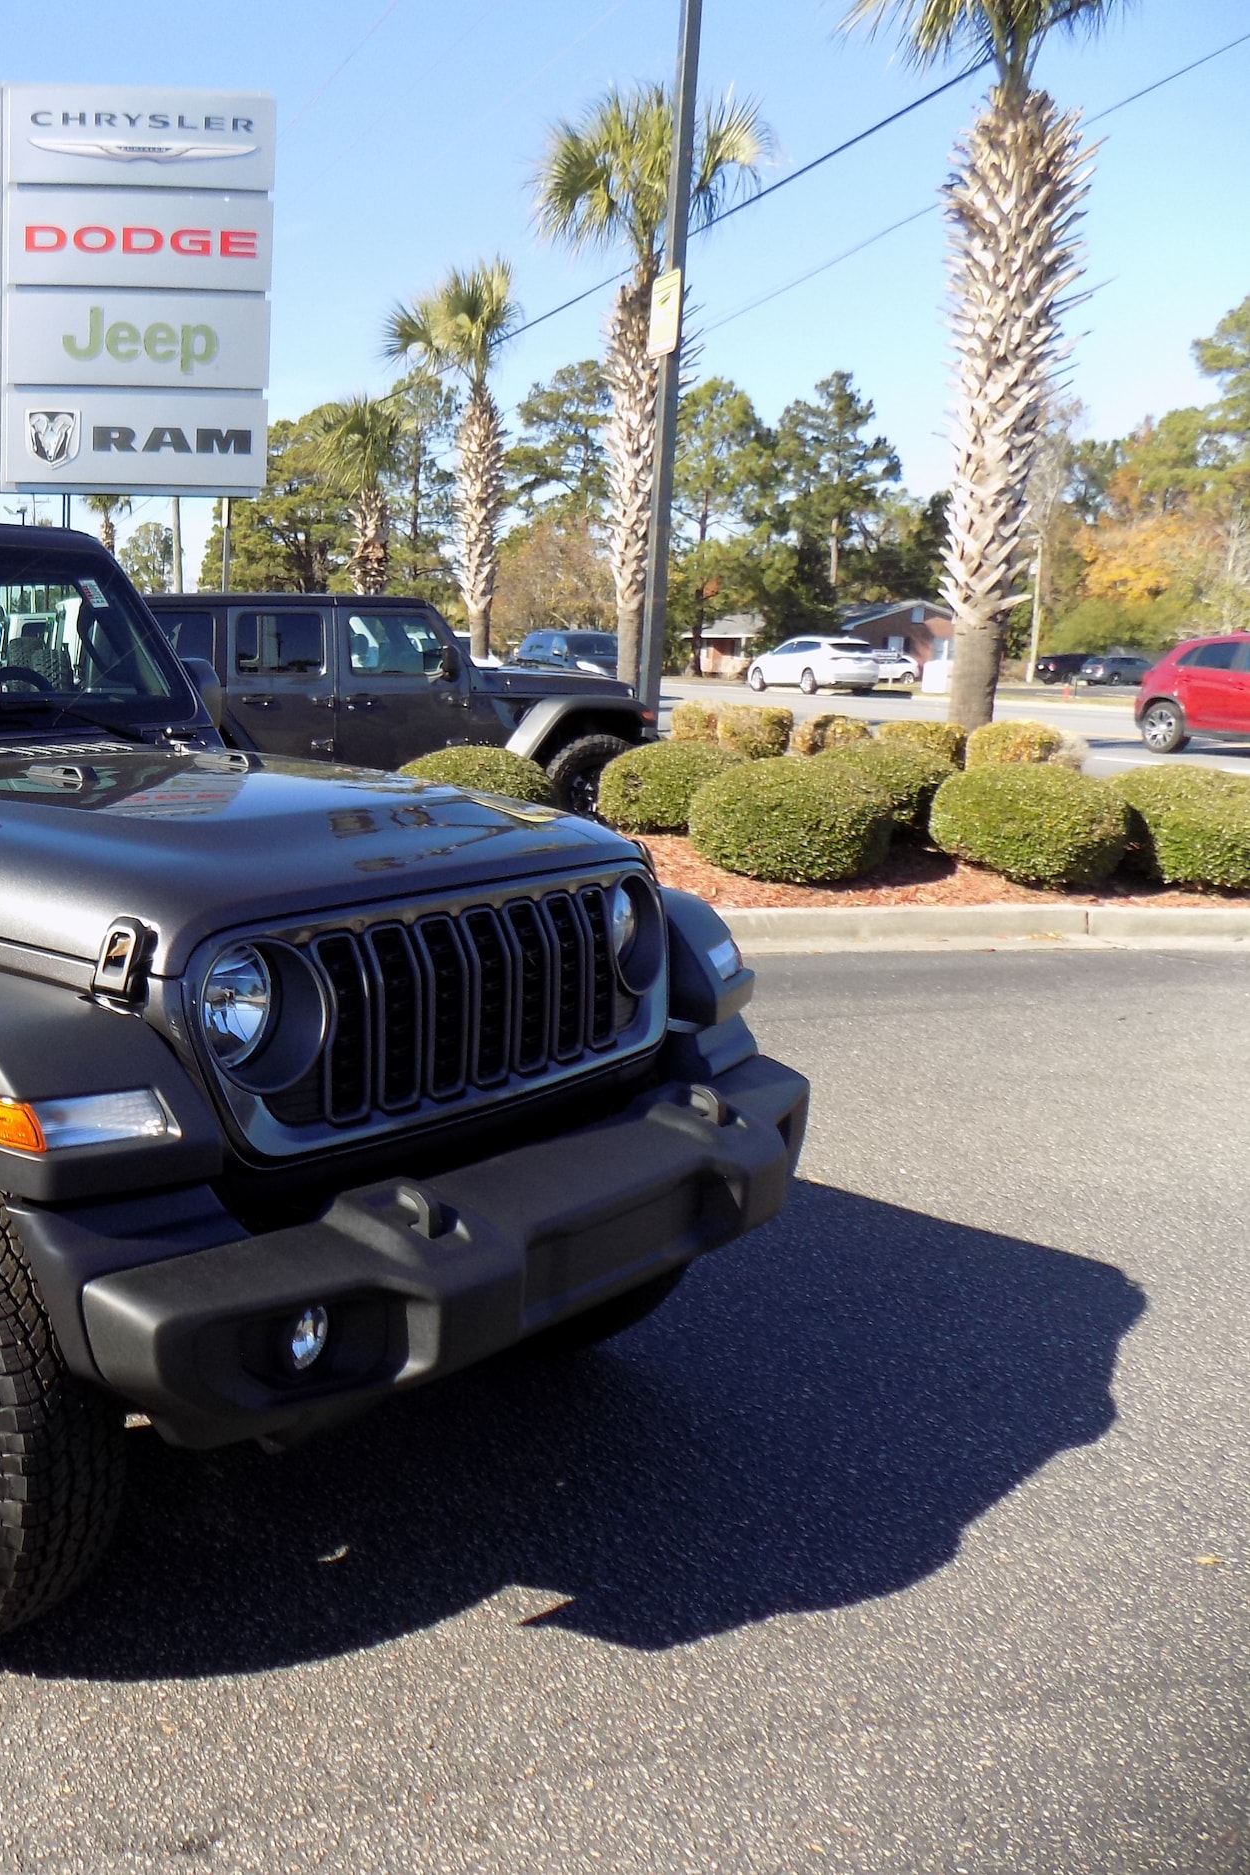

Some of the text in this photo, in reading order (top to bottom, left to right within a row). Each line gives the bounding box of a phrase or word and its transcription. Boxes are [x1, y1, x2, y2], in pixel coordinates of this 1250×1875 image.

[30, 111, 254, 134] CHRYSLER
[25, 225, 257, 258] DODGE
[62, 306, 217, 373] Jeep
[92, 426, 252, 455] RAM
